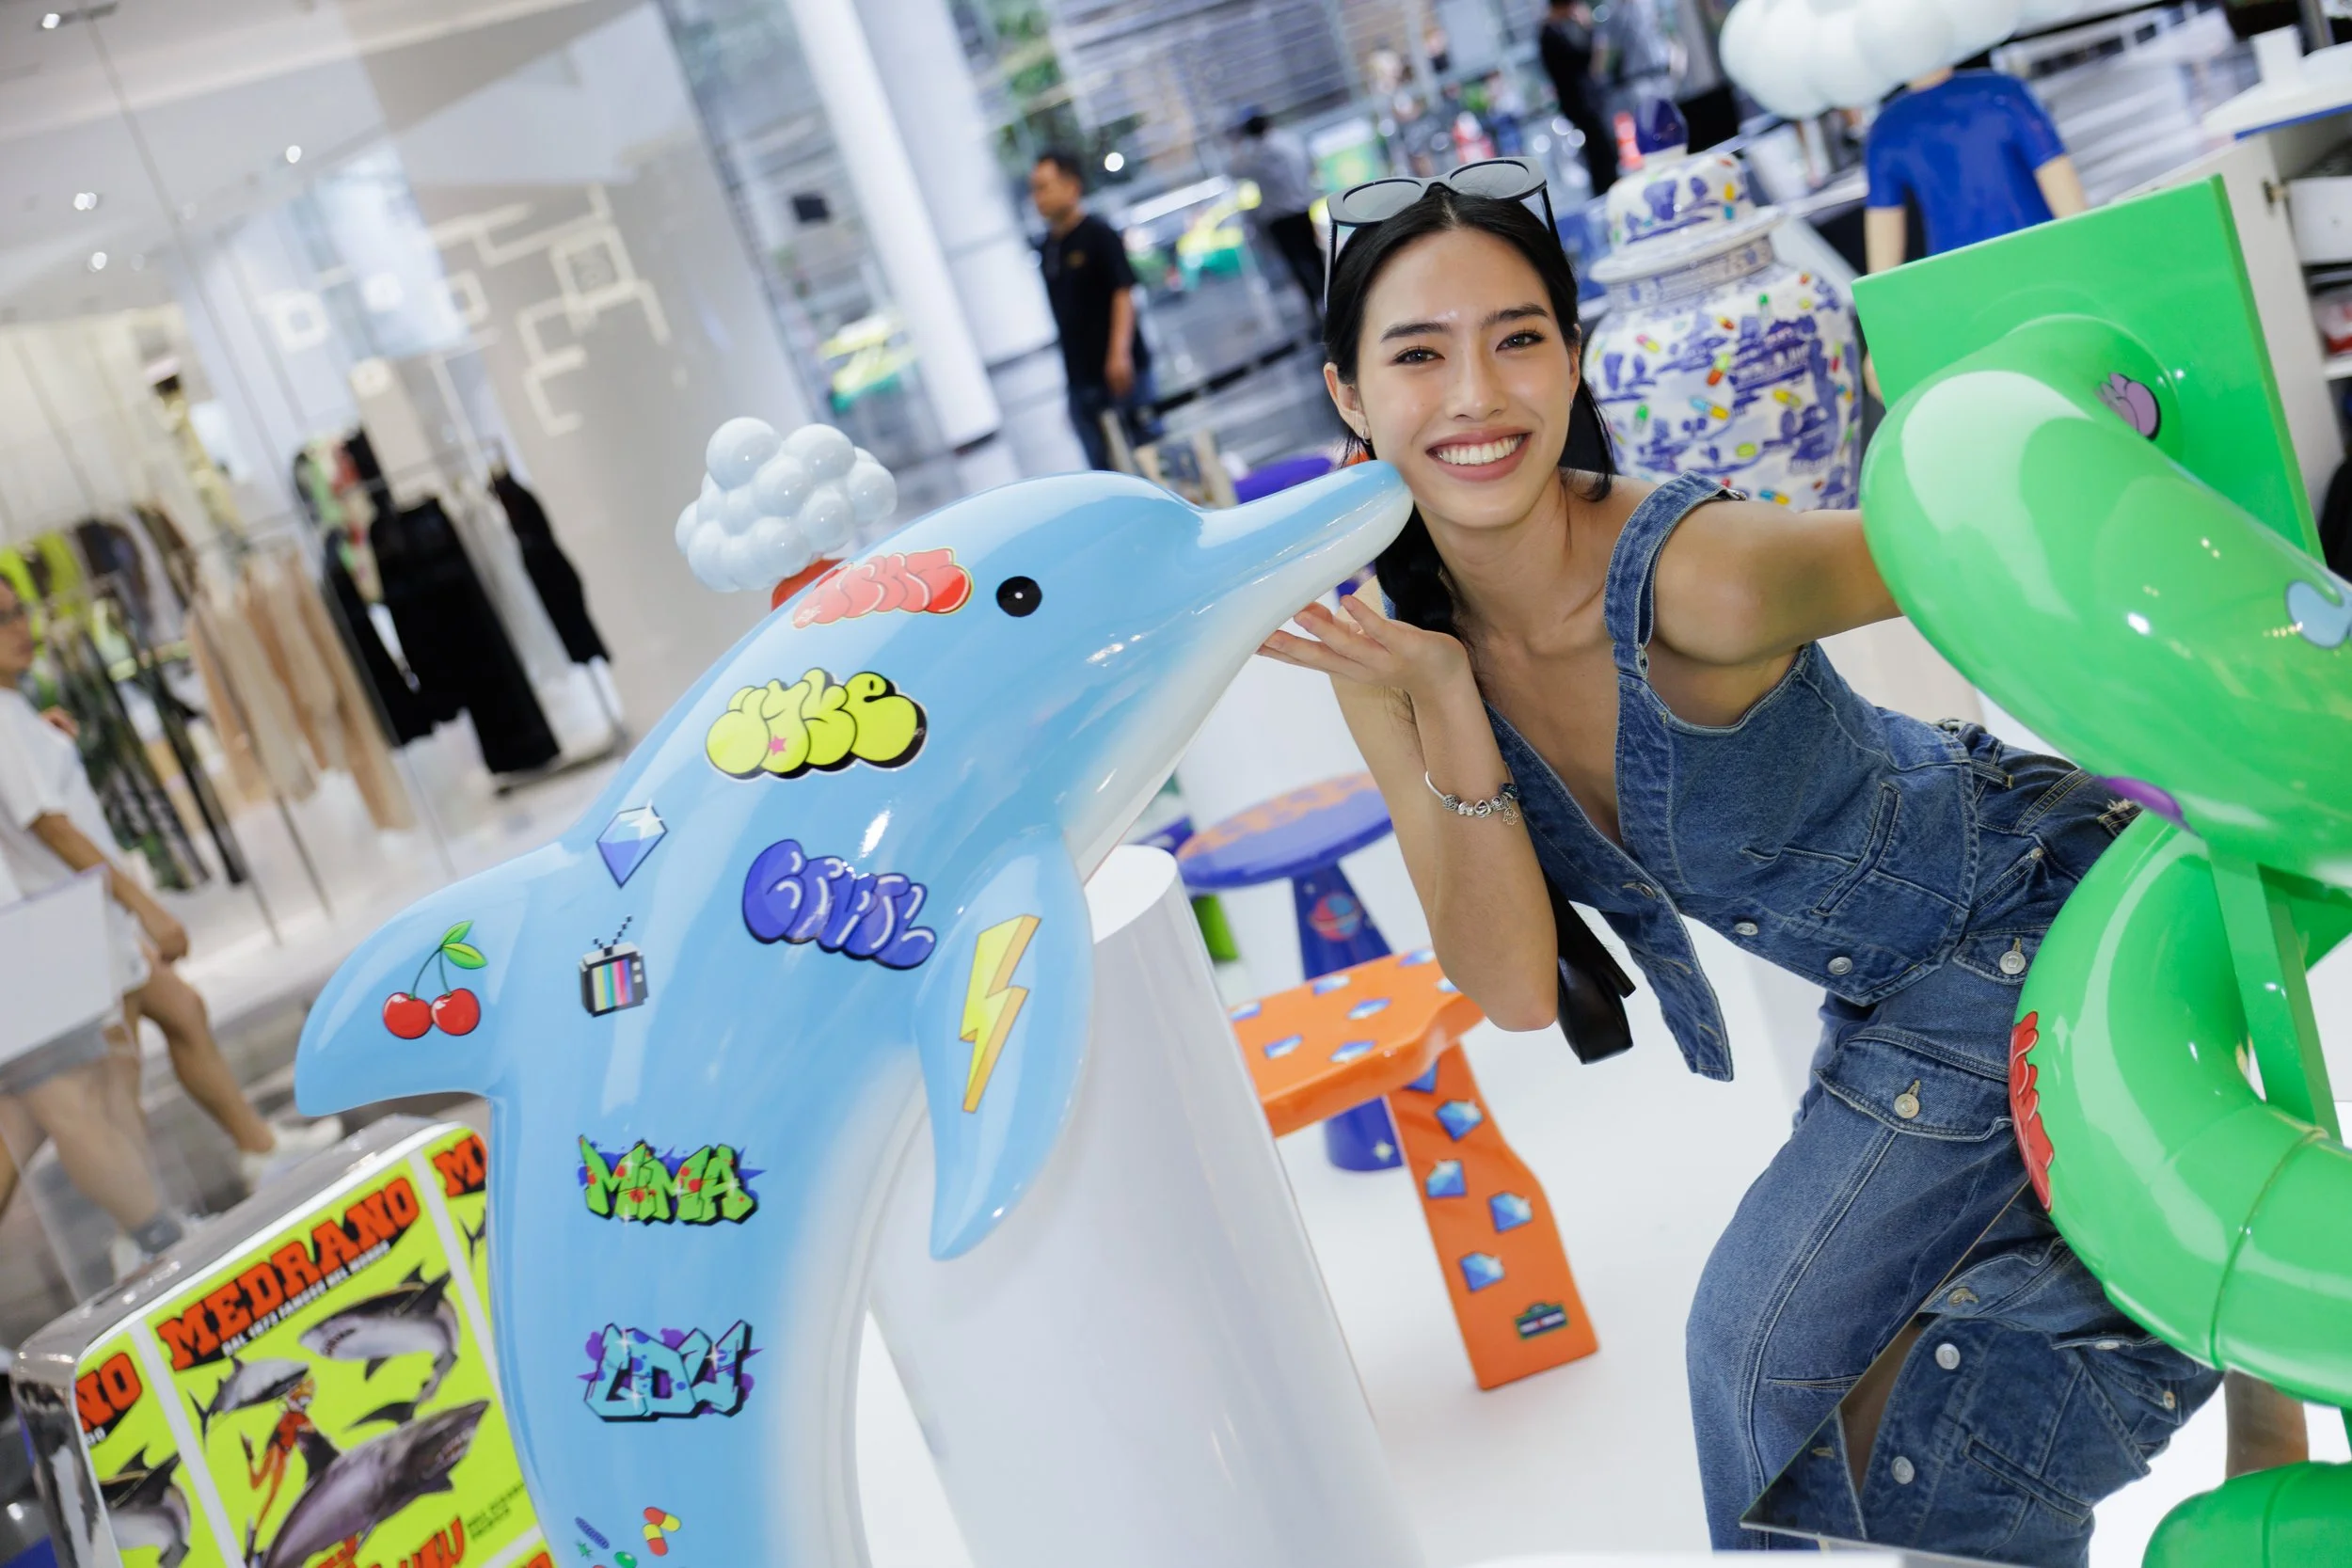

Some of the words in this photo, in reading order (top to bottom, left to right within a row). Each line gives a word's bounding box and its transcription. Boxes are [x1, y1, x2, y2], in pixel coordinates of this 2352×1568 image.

[433, 1132, 487, 1197] M
[155, 1176, 421, 1371] MEDRANO
[75, 1351, 143, 1433] NO
